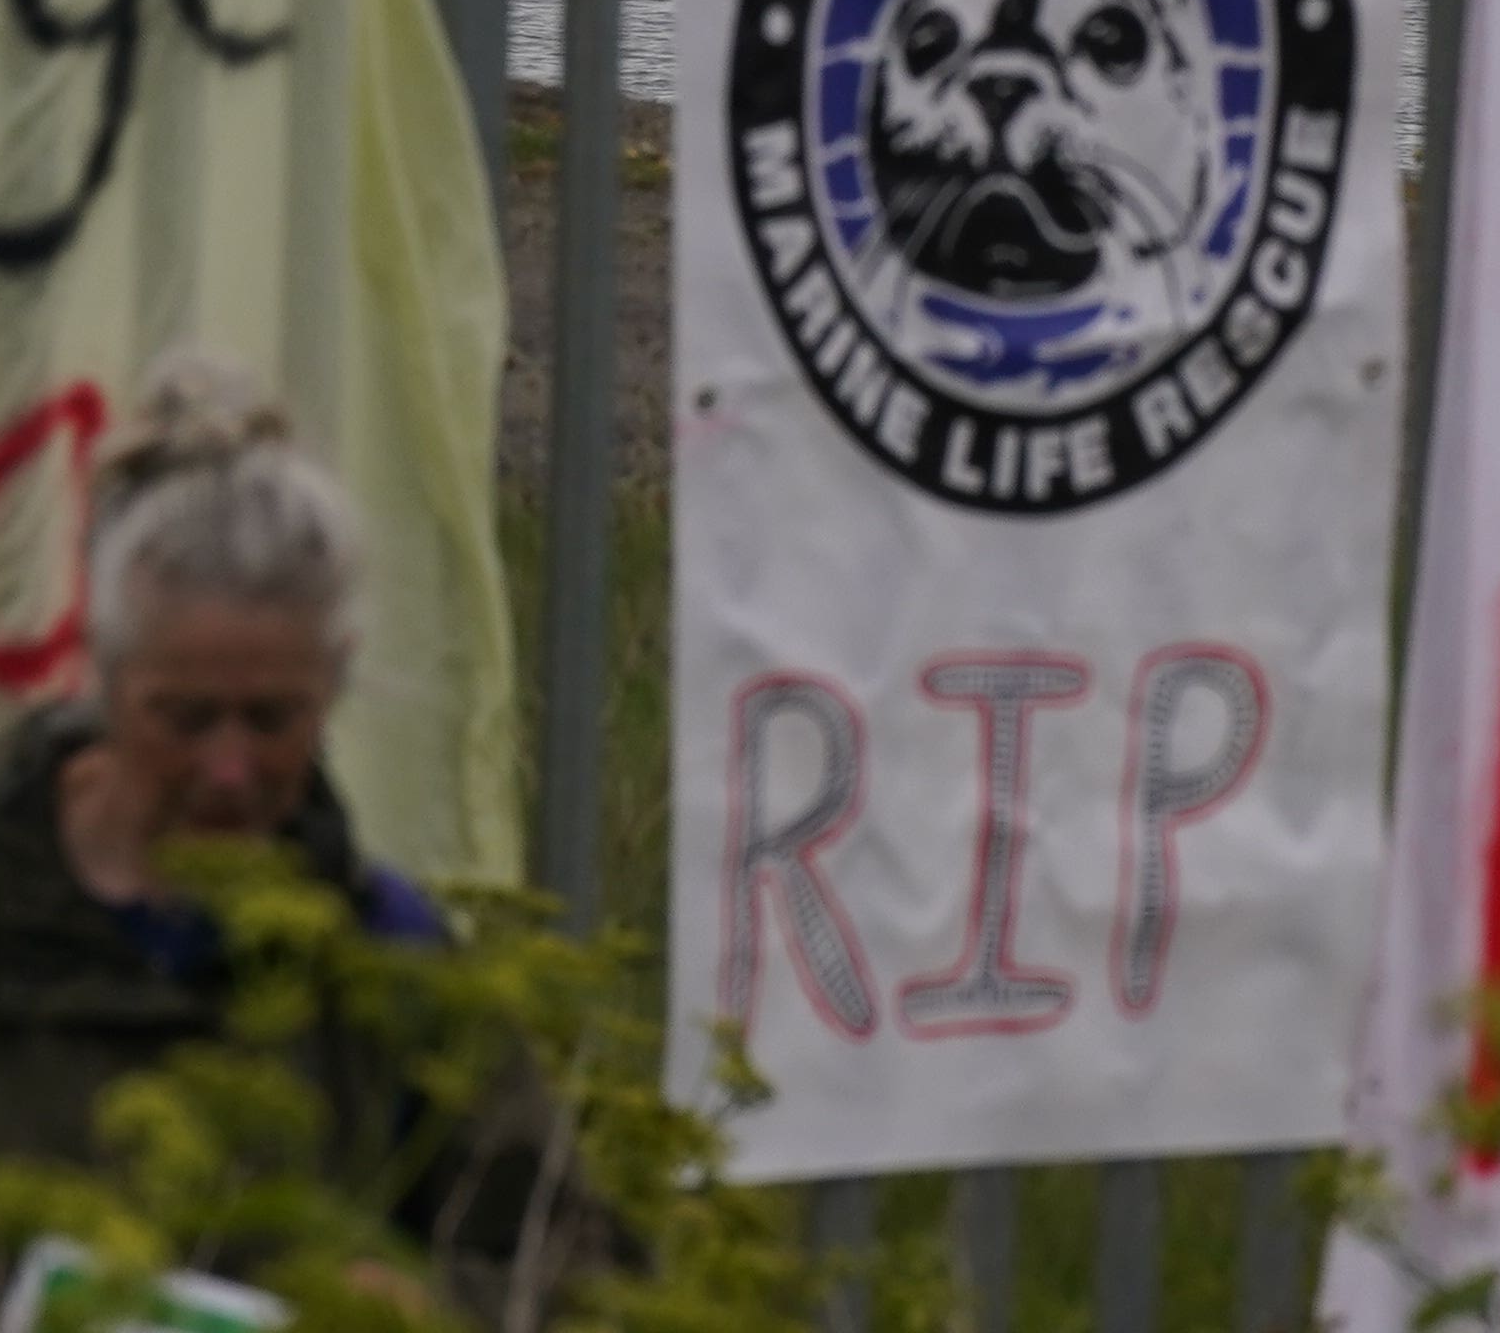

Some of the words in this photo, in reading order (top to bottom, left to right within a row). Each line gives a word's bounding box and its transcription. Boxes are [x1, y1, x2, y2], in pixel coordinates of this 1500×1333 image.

[740, 118, 935, 470] MARINE
[940, 415, 1116, 501] LIFE
[1130, 105, 1346, 461] RESCUE
[728, 641, 1270, 1043] RIP
